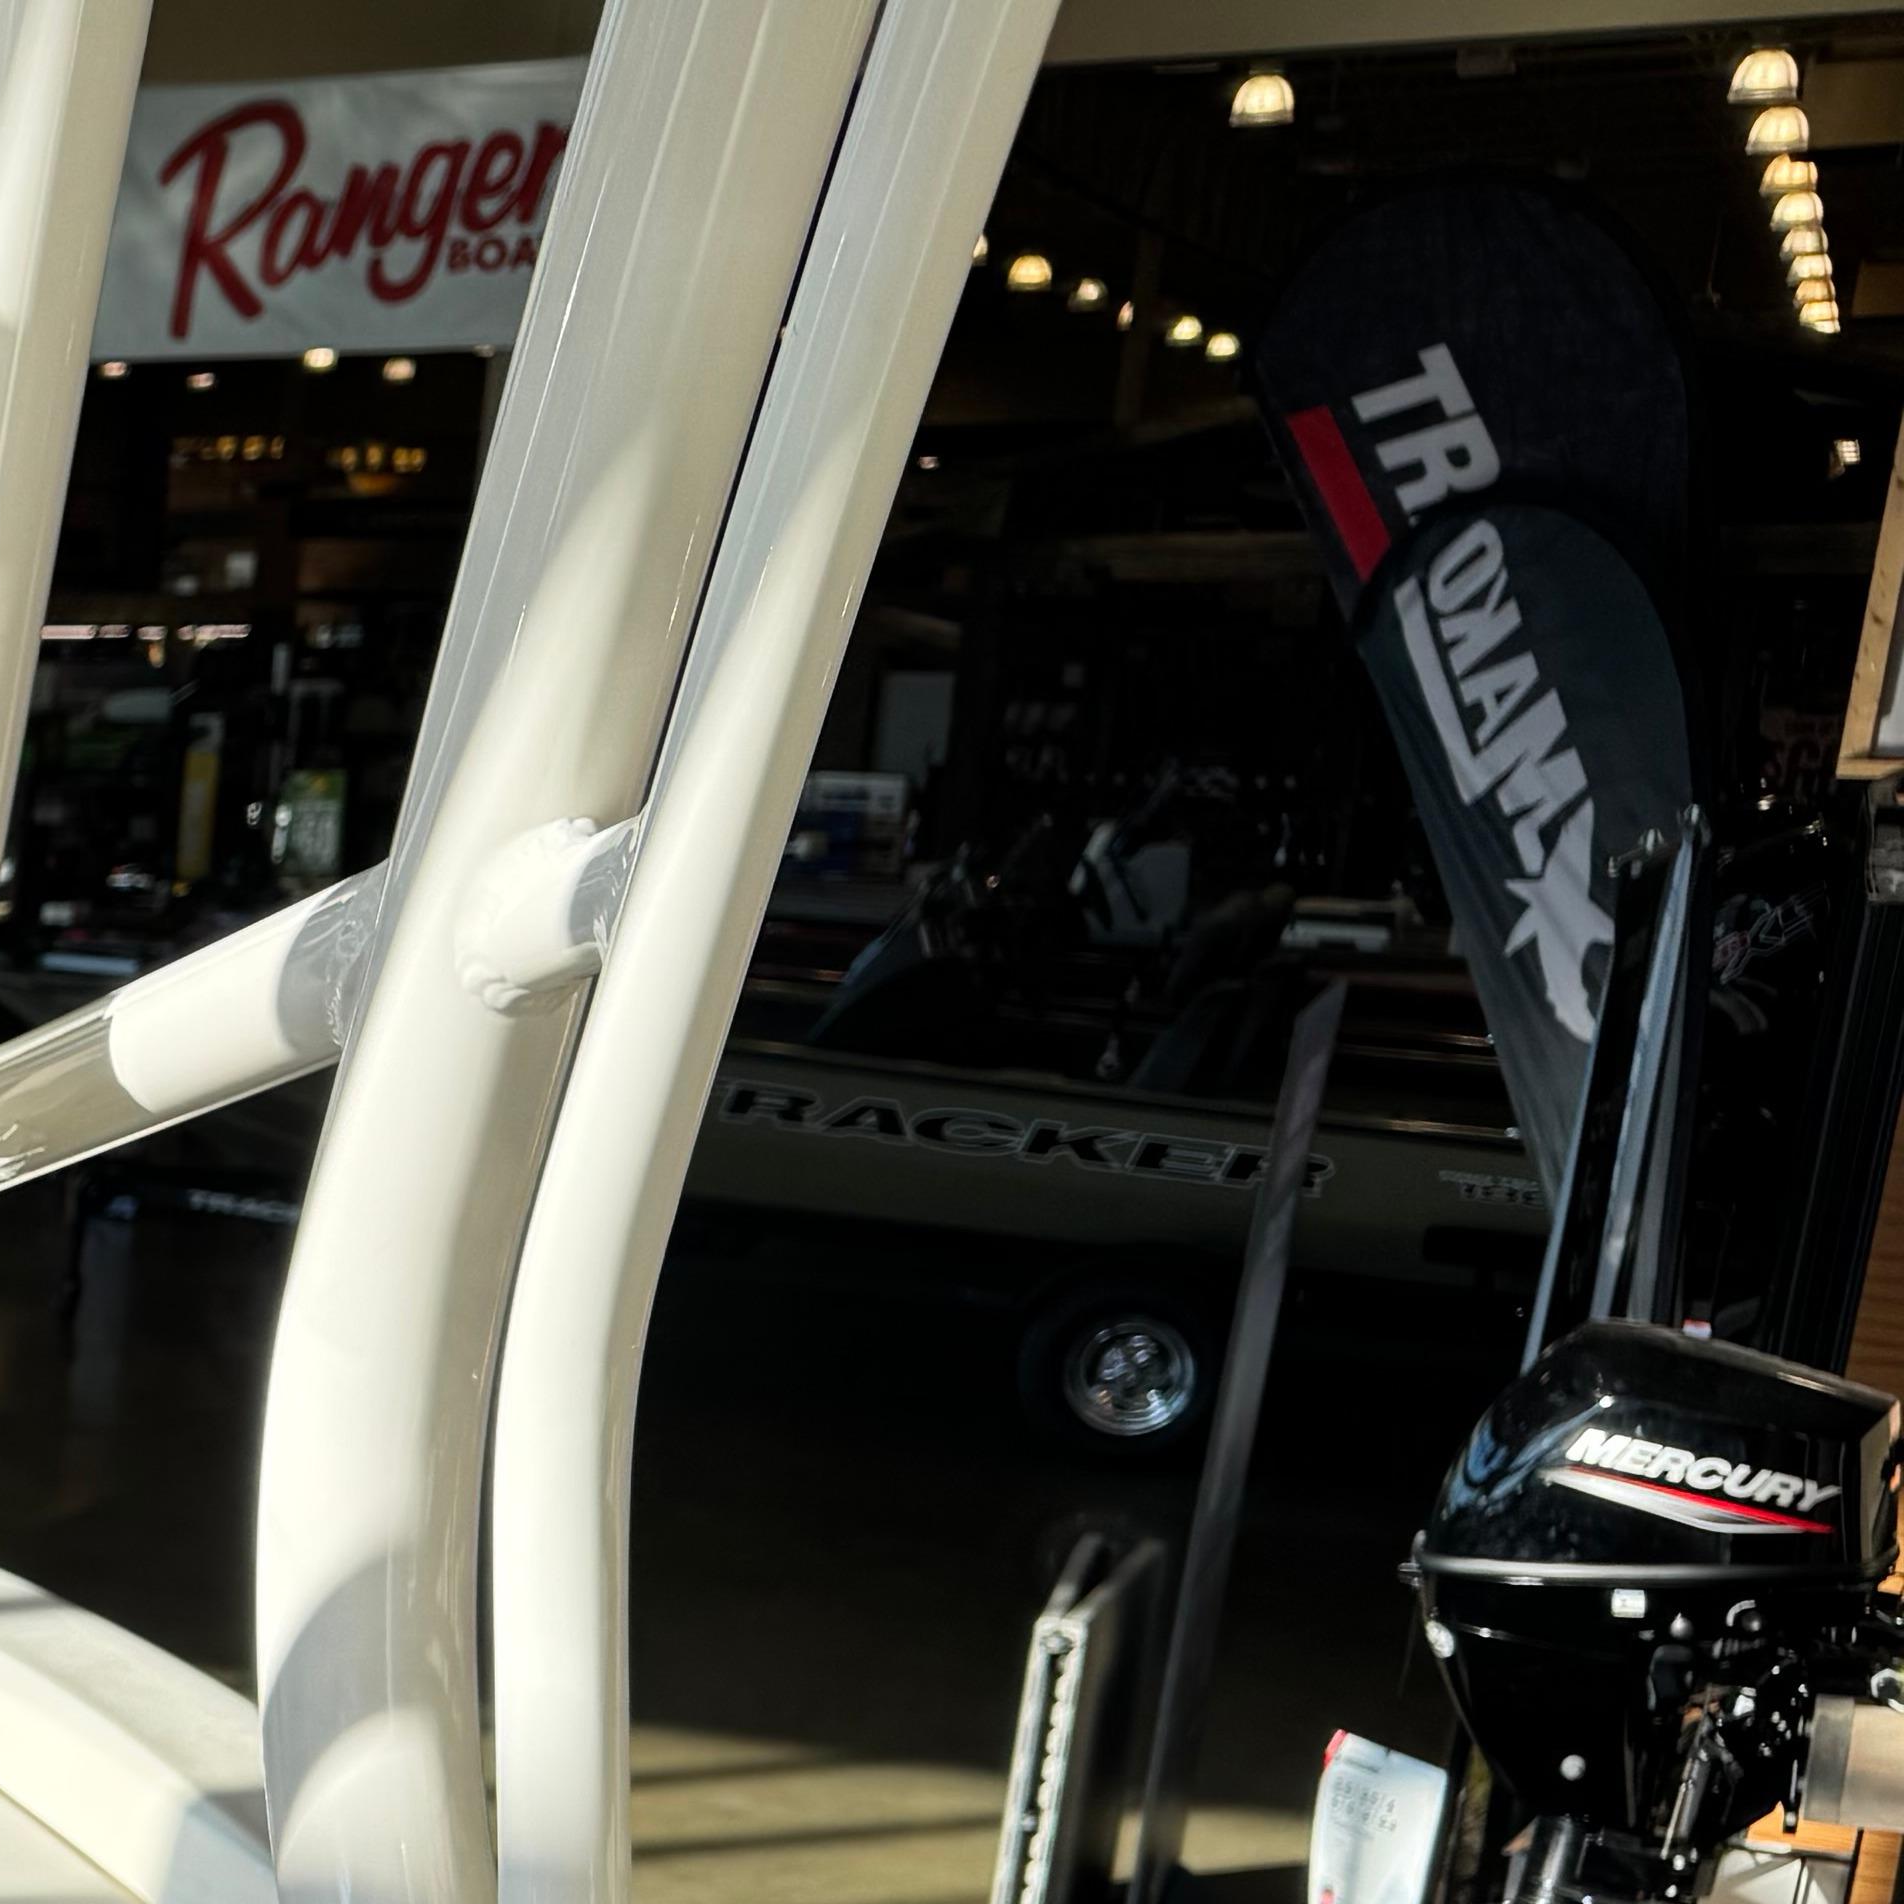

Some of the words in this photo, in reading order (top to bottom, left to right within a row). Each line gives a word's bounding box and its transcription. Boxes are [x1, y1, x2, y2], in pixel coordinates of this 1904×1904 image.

[159, 98, 568, 341] Ranger
[446, 236, 540, 274] BOA
[1564, 1427, 1842, 1513] MERCURY
